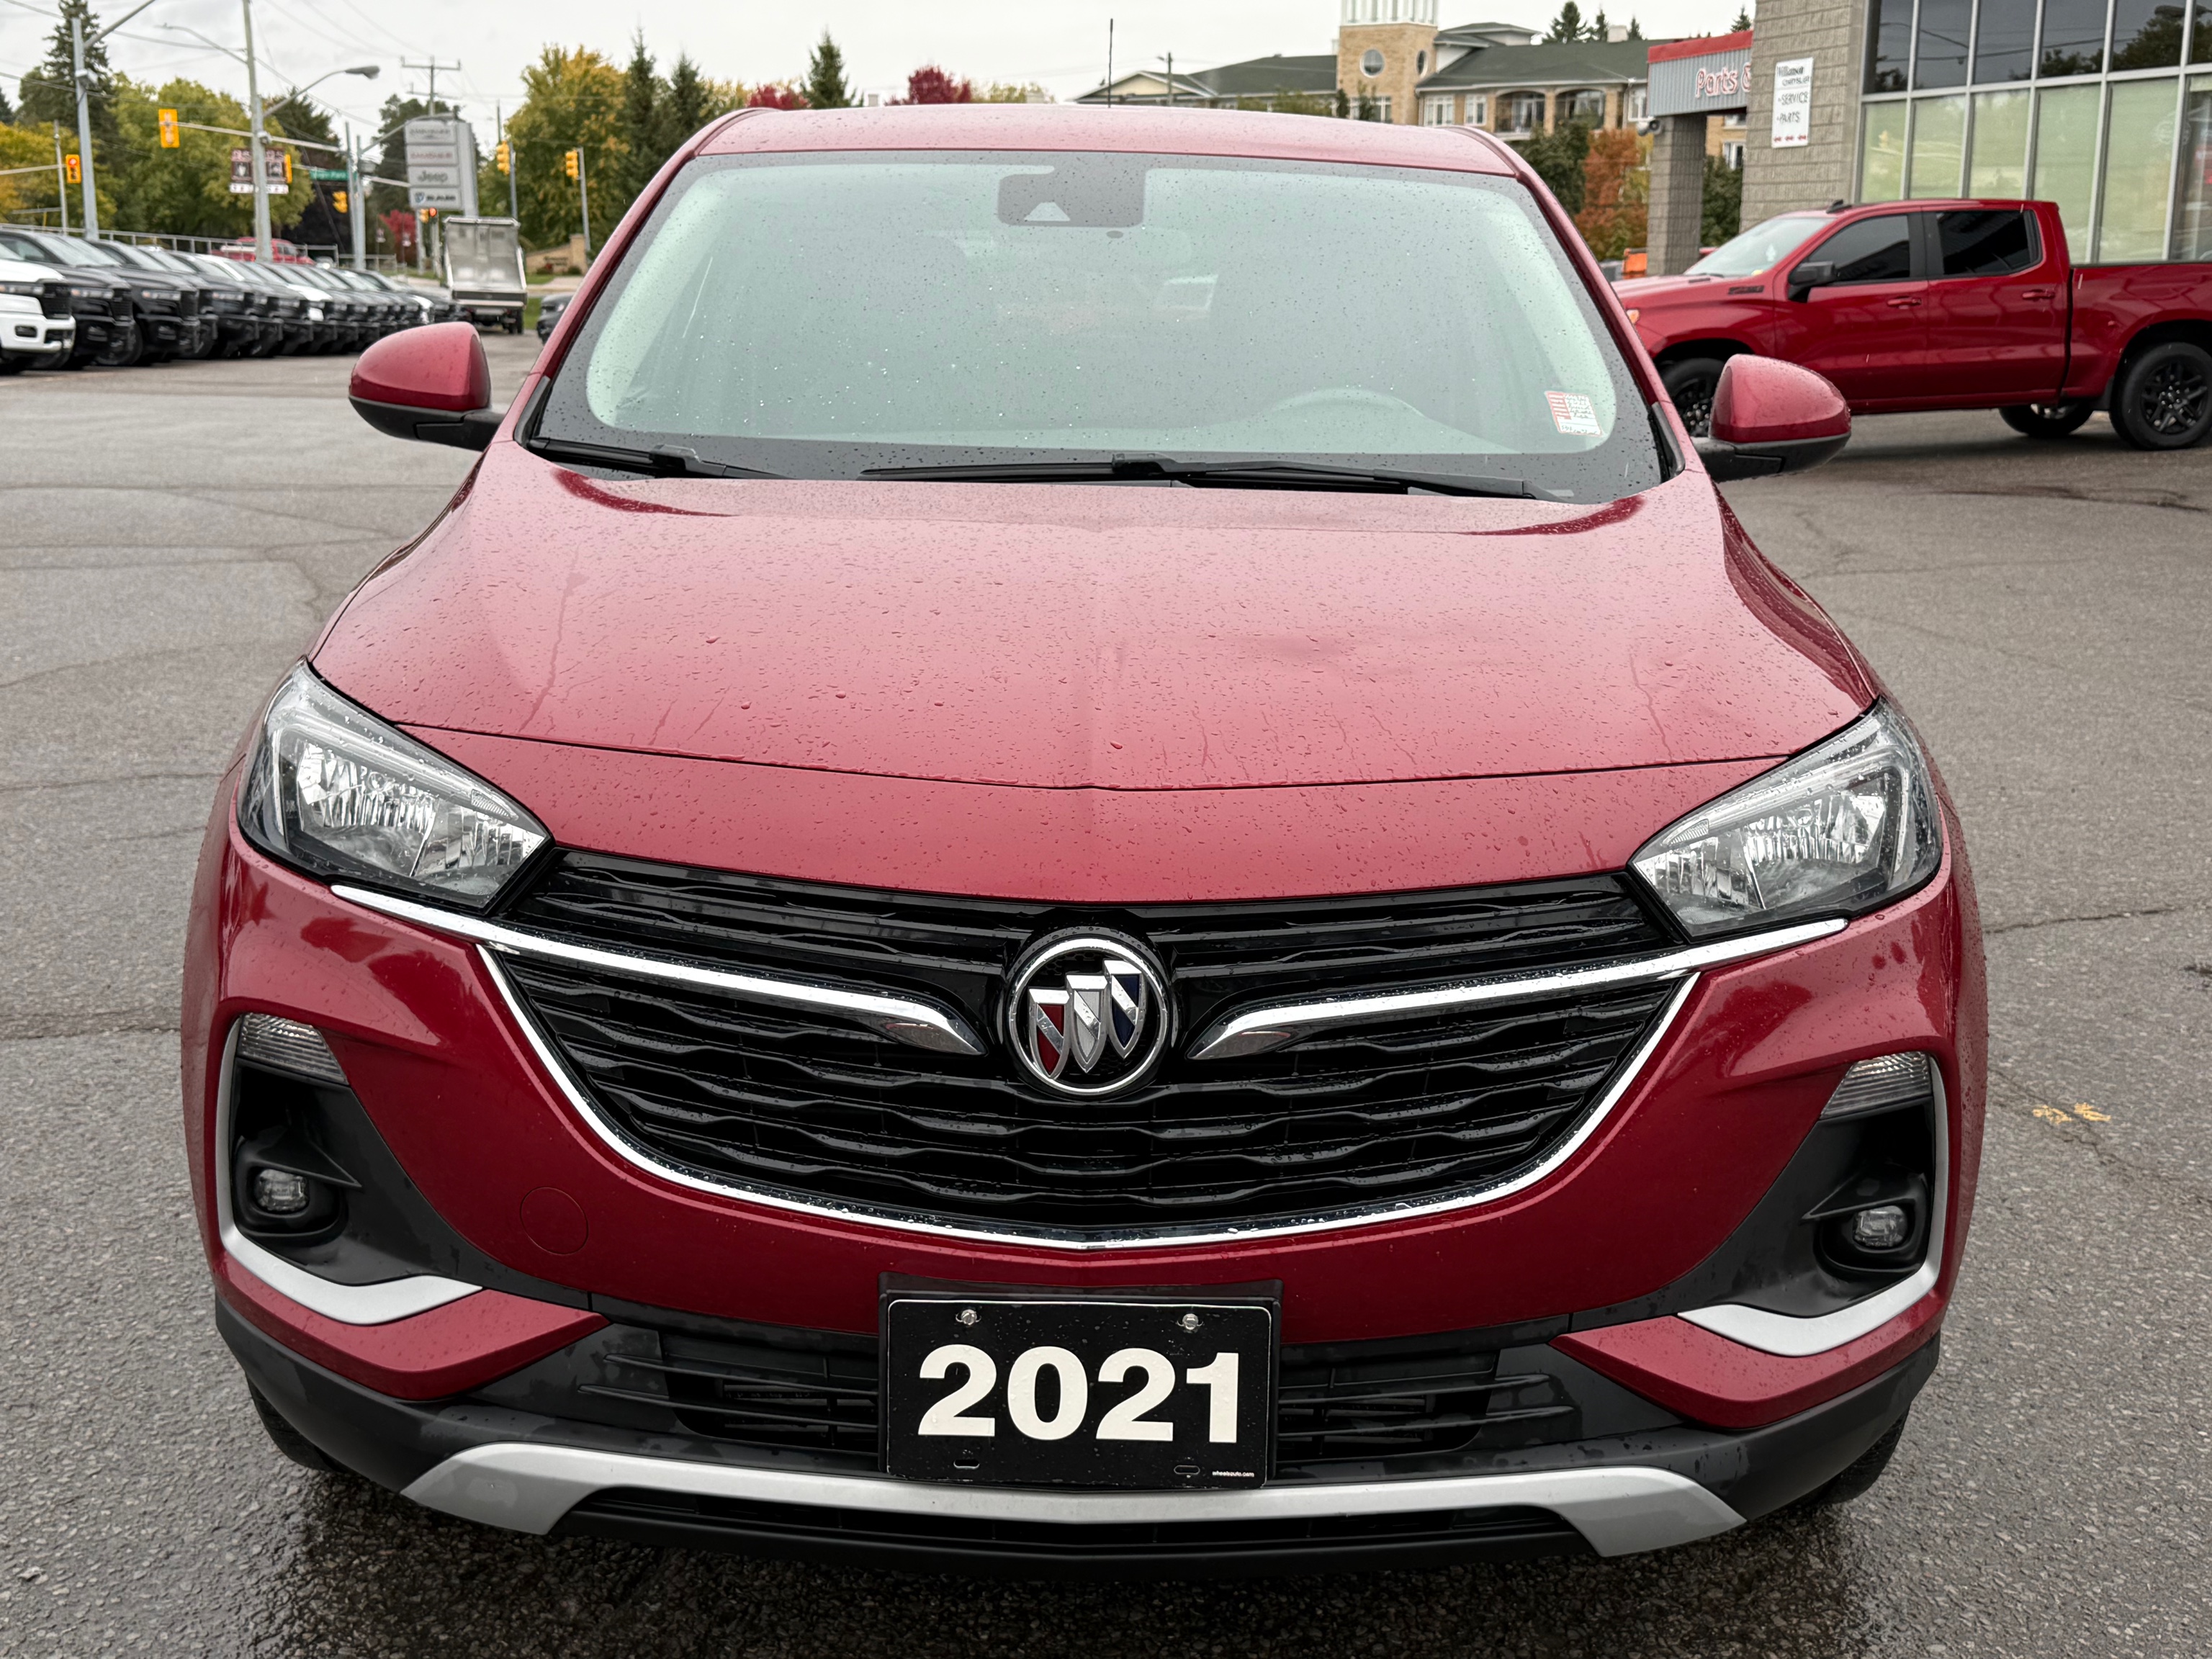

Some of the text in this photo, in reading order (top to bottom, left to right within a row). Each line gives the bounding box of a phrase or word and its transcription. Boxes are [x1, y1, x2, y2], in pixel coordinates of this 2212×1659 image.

[1694, 66, 1738, 99] Parts
[1781, 91, 1809, 106] SERVICE
[1779, 111, 1801, 125] PARTS
[917, 1344, 1239, 1444] 2021
